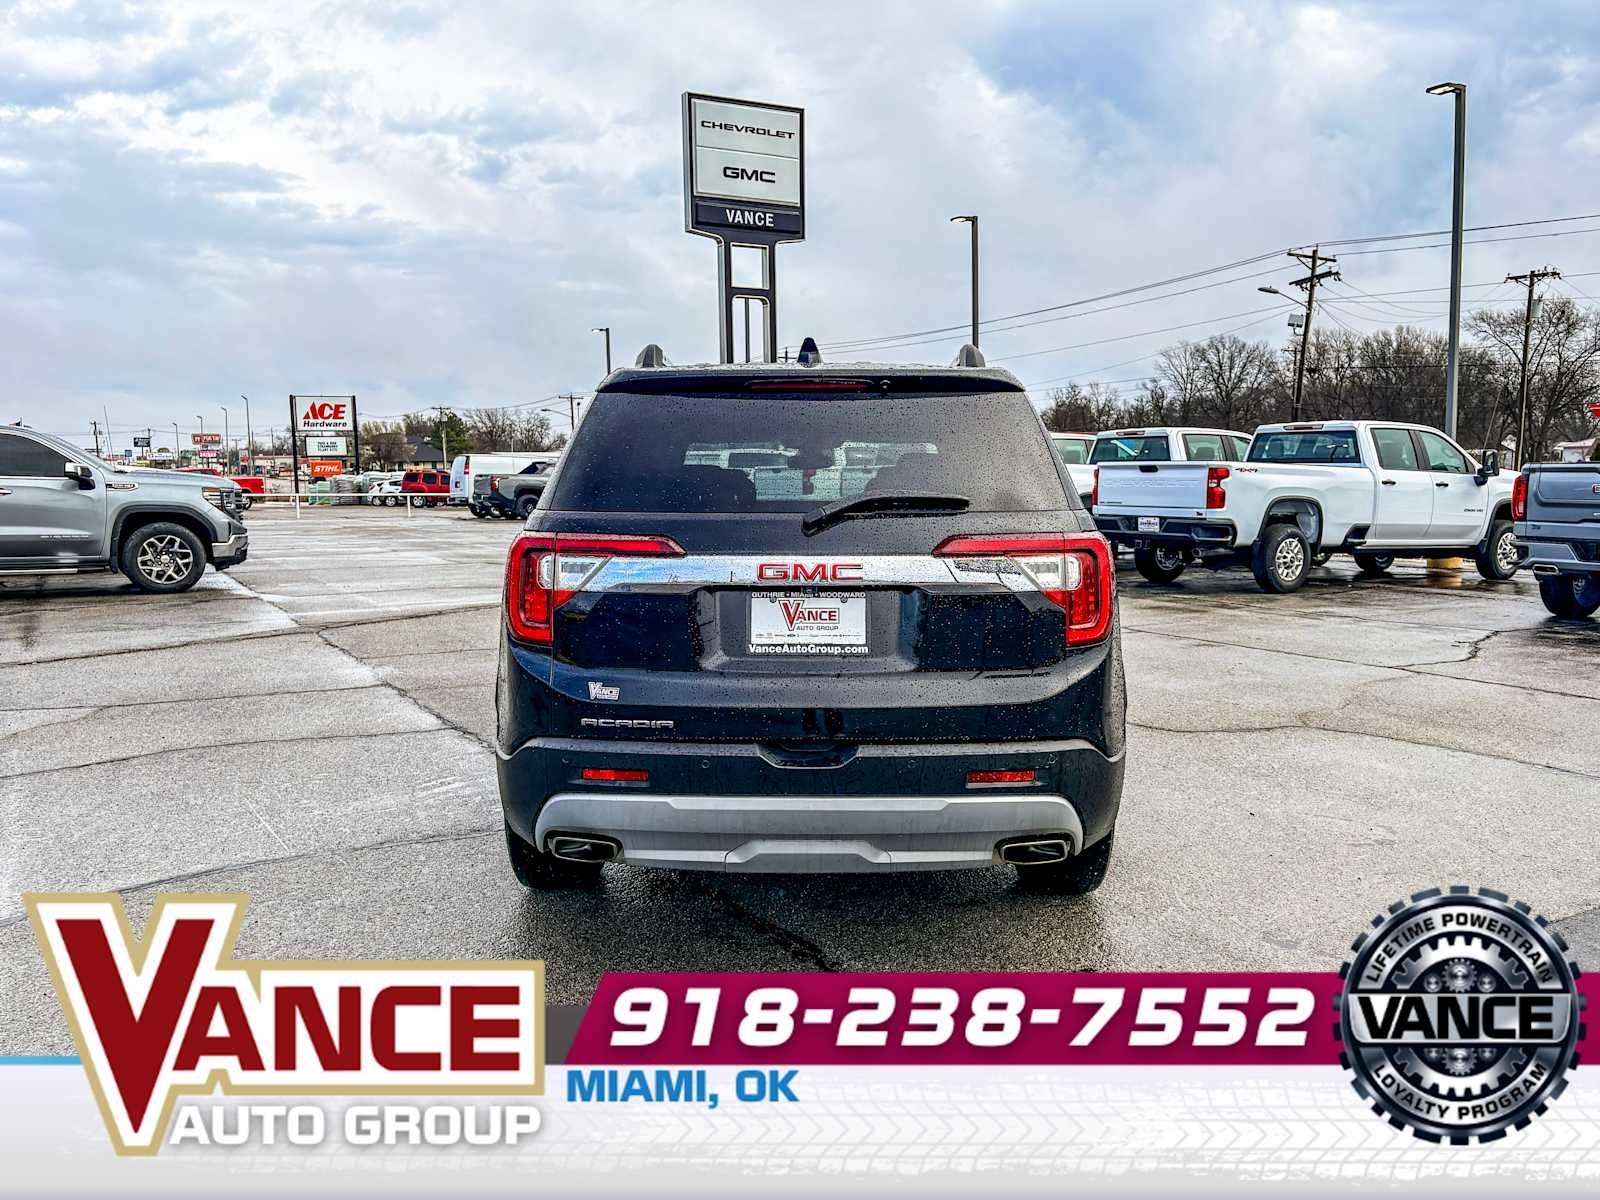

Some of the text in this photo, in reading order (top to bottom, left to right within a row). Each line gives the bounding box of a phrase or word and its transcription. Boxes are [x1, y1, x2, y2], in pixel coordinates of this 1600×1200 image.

[701, 120, 795, 139] CHEVROLET
[723, 166, 776, 184] GMC
[726, 209, 775, 227] VANCE
[303, 401, 347, 420] ACE
[303, 420, 348, 428] Hardware
[314, 465, 340, 473] STIHL
[758, 563, 864, 582] GMC
[782, 601, 838, 628] VANCE
[749, 644, 869, 655] VanceAutoGroup.com
[588, 682, 620, 700] VANCE
[581, 718, 674, 728] ACADIA
